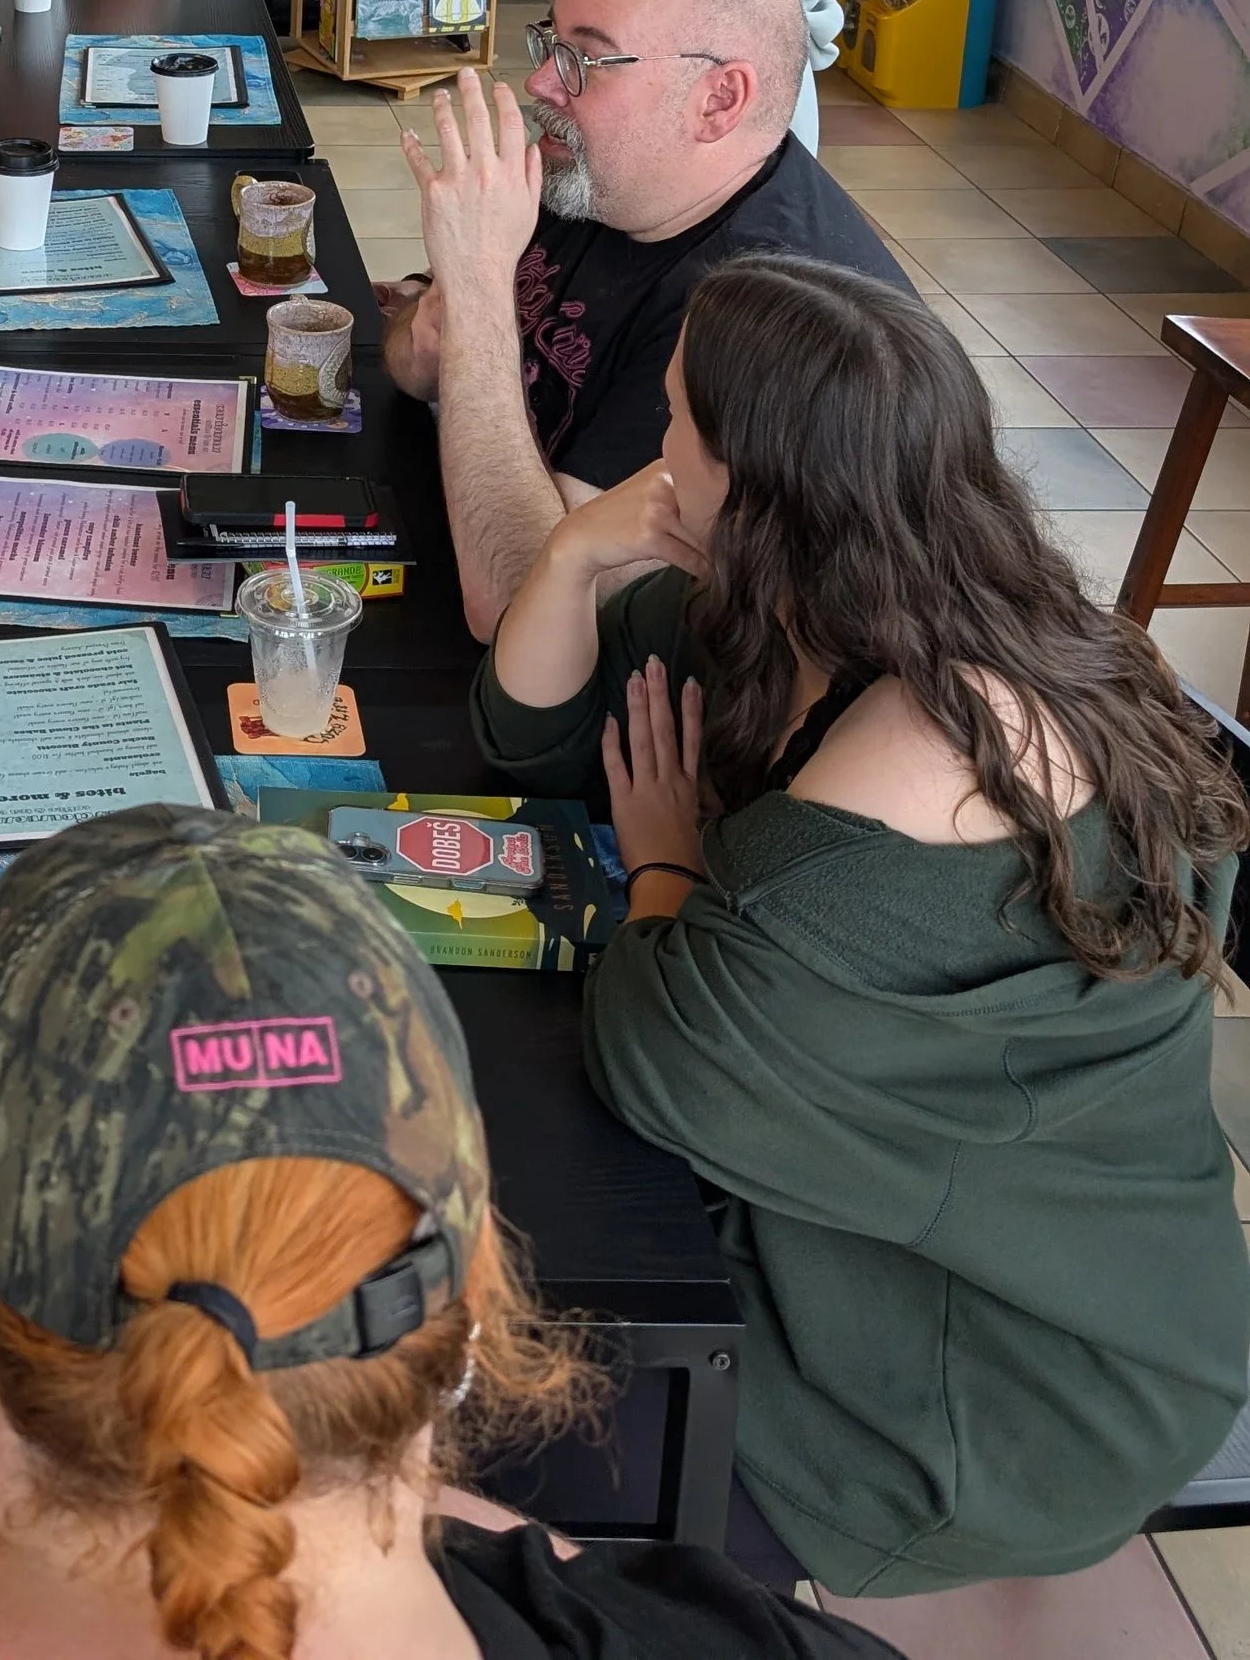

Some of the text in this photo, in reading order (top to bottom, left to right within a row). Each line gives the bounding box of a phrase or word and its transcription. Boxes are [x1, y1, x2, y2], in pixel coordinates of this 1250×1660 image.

[188, 400, 202, 455] essentials menu
[37, 654, 62, 662] juice
[64, 650, 104, 659] pressed
[63, 666, 114, 674] chocolate
[81, 739, 120, 747] County
[122, 736, 155, 744] Bucks
[103, 752, 161, 762] croissants
[129, 769, 166, 777] bagels
[55, 792, 70, 800] &
[75, 787, 126, 798] bites
[426, 822, 461, 869] DOBEŠ
[430, 945, 531, 960] BRANDON SANDERSON
